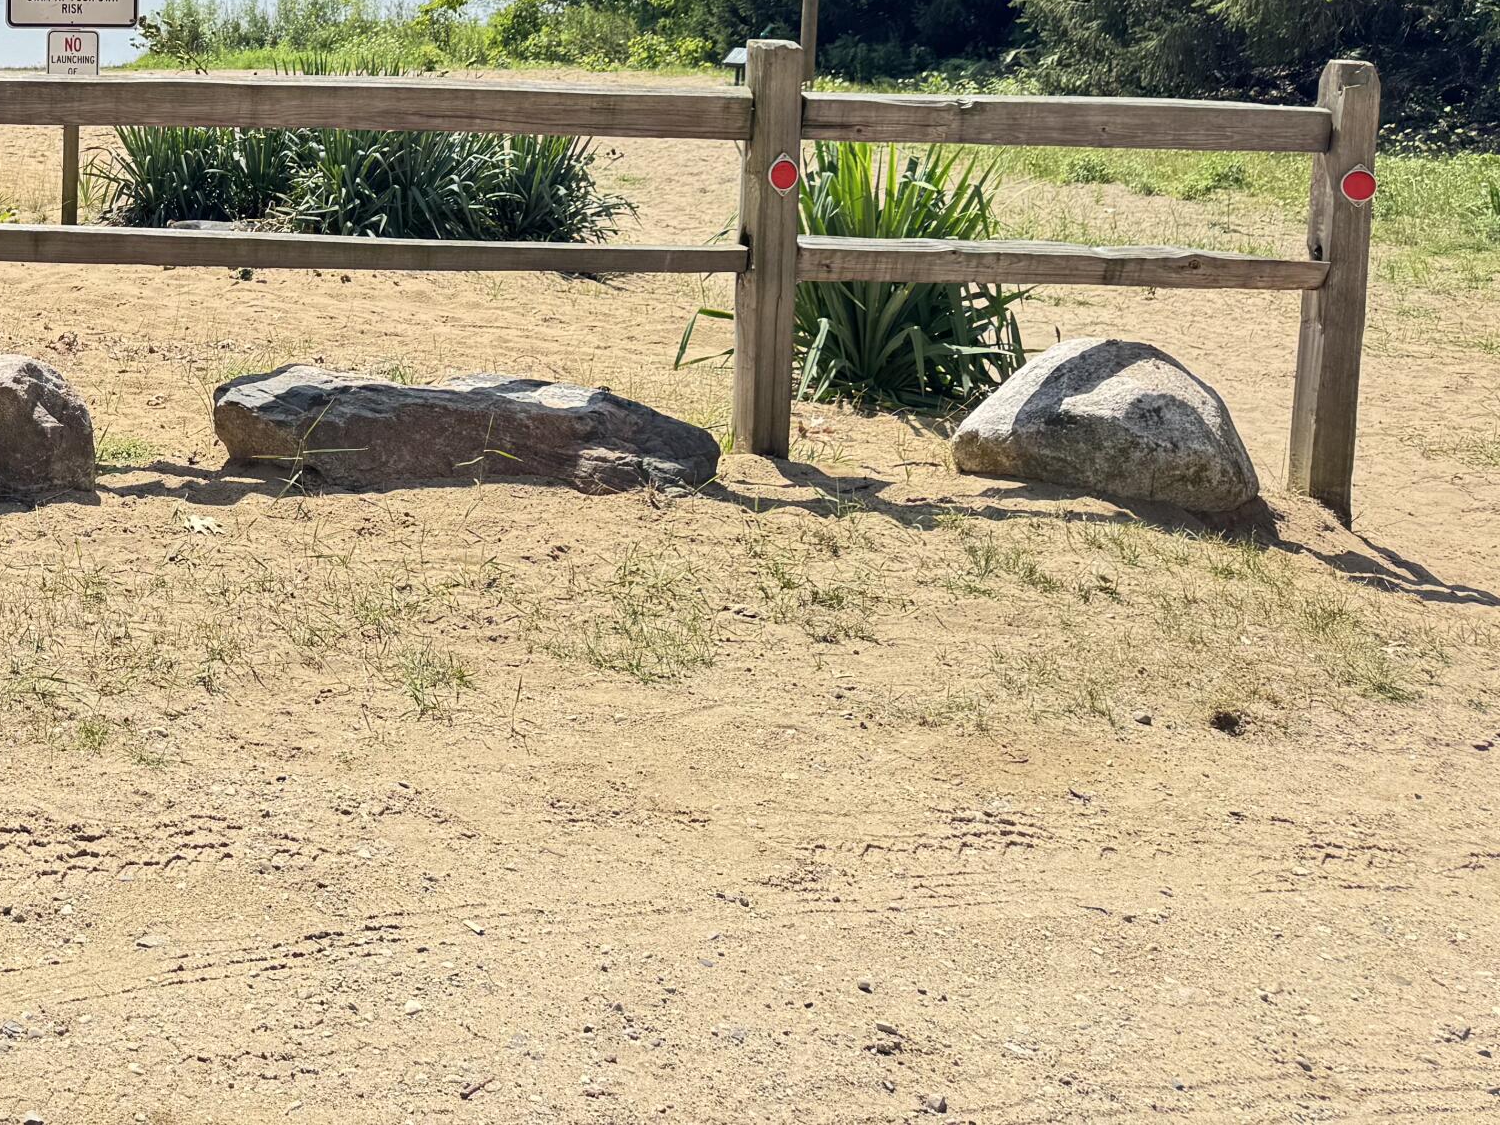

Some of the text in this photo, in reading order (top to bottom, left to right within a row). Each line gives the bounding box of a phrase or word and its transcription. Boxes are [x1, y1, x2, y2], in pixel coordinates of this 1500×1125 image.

[61, 3, 83, 14] RISK
[64, 37, 82, 52] NO
[51, 55, 95, 64] LAUNCHING
